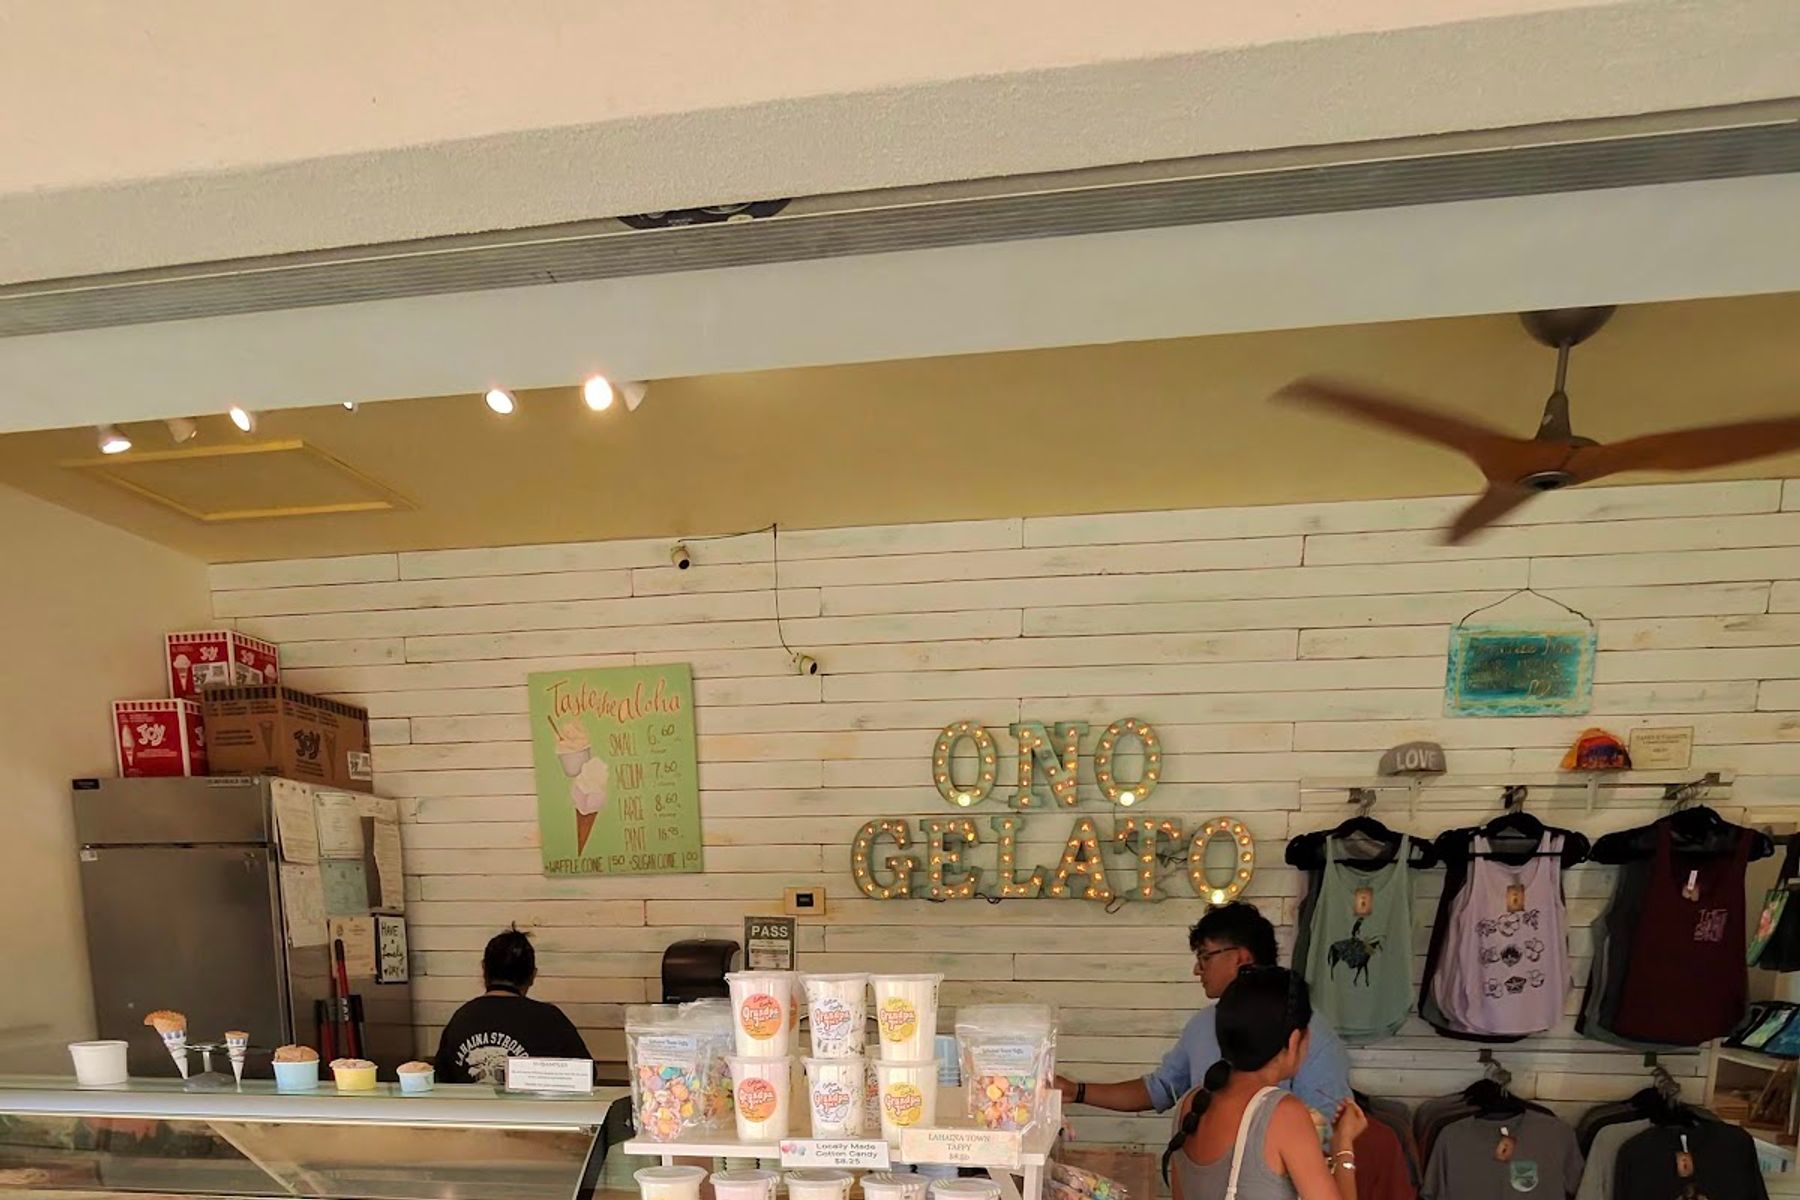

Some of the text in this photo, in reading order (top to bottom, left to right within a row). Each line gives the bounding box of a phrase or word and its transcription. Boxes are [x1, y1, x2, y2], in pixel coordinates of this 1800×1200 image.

[932, 717, 1162, 808] ONO
[1396, 747, 1438, 771] LOVE
[851, 815, 1256, 905] GELATO
[751, 925, 788, 938] PASS
[455, 1032, 489, 1066] LAHAINA
[816, 1143, 848, 1151] Locally
[849, 1151, 877, 1159] Candy
